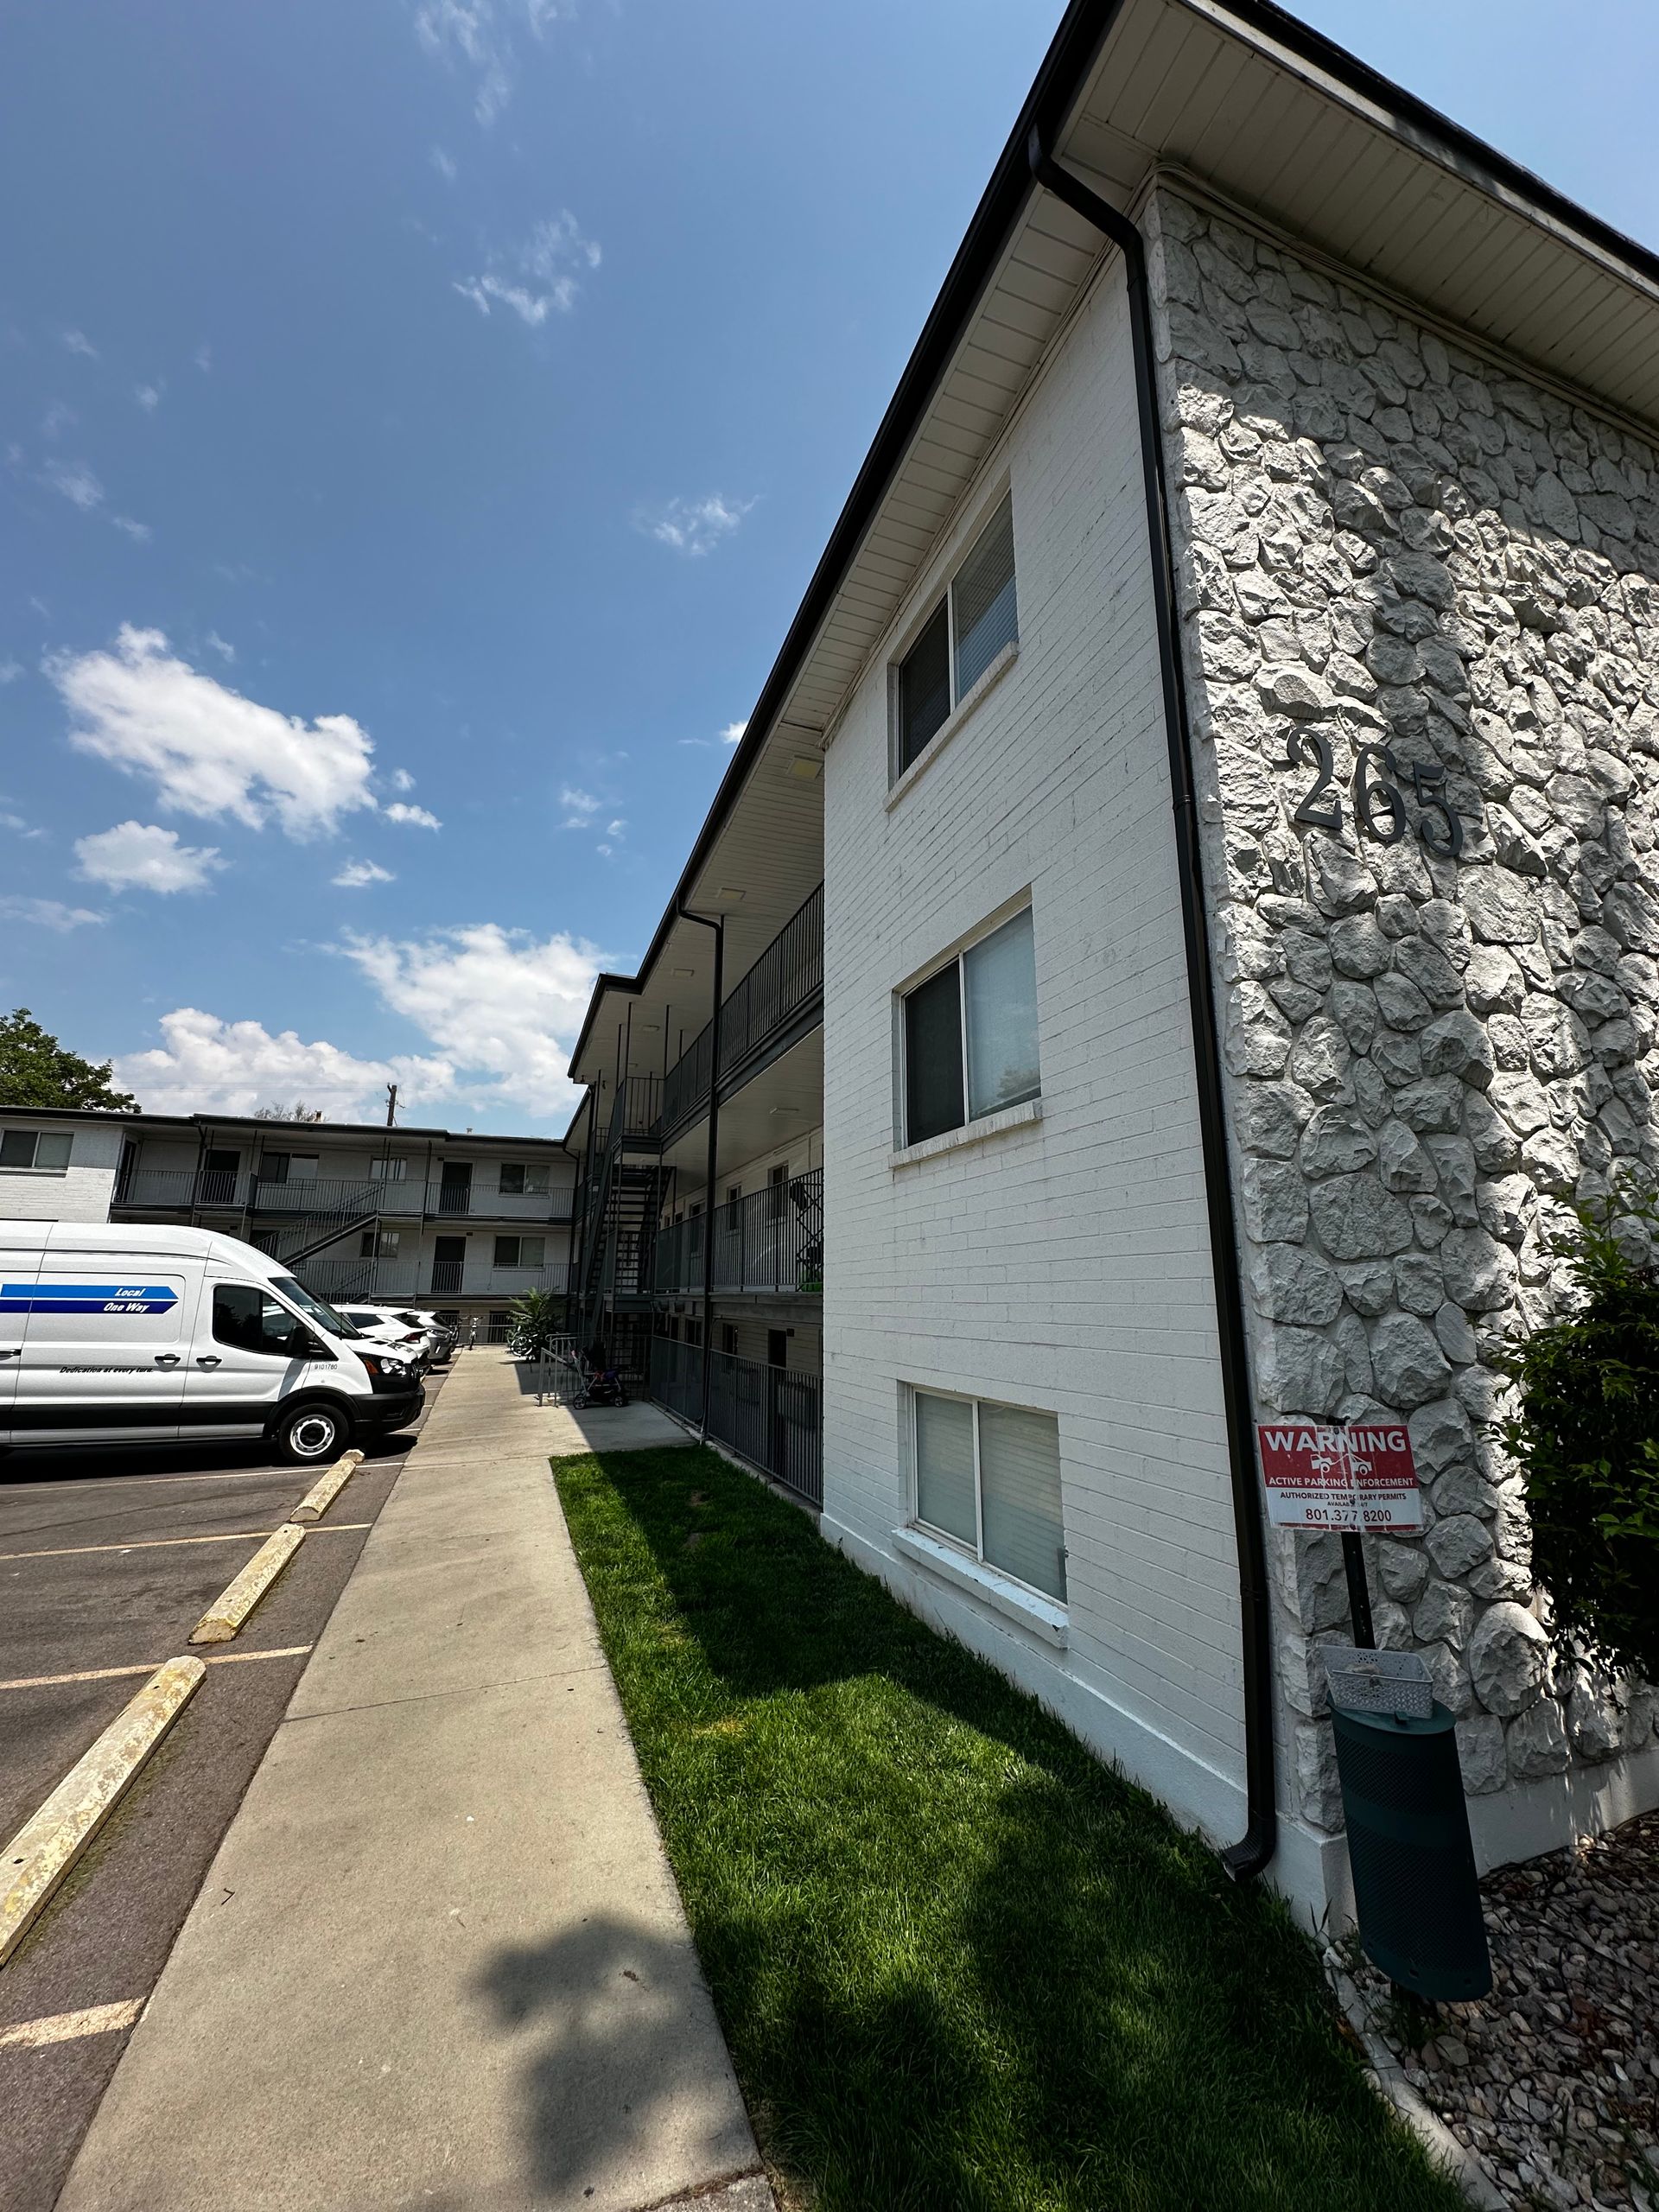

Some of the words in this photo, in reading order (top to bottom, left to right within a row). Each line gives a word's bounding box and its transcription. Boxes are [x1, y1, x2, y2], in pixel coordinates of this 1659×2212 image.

[1287, 727, 1463, 857] 265
[115, 1287, 146, 1296] Local
[104, 1302, 125, 1311] One
[125, 1302, 150, 1313] Way
[1264, 1431, 1407, 1452] WARNING
[1269, 1477, 1302, 1485] ACTIVE
[1304, 1478, 1348, 1487] PARKING
[1350, 1478, 1414, 1487] ENFORCEMENT
[1280, 1491, 1329, 1500] AUTHORIZED
[1306, 1509, 1392, 1522] 801.3778200
